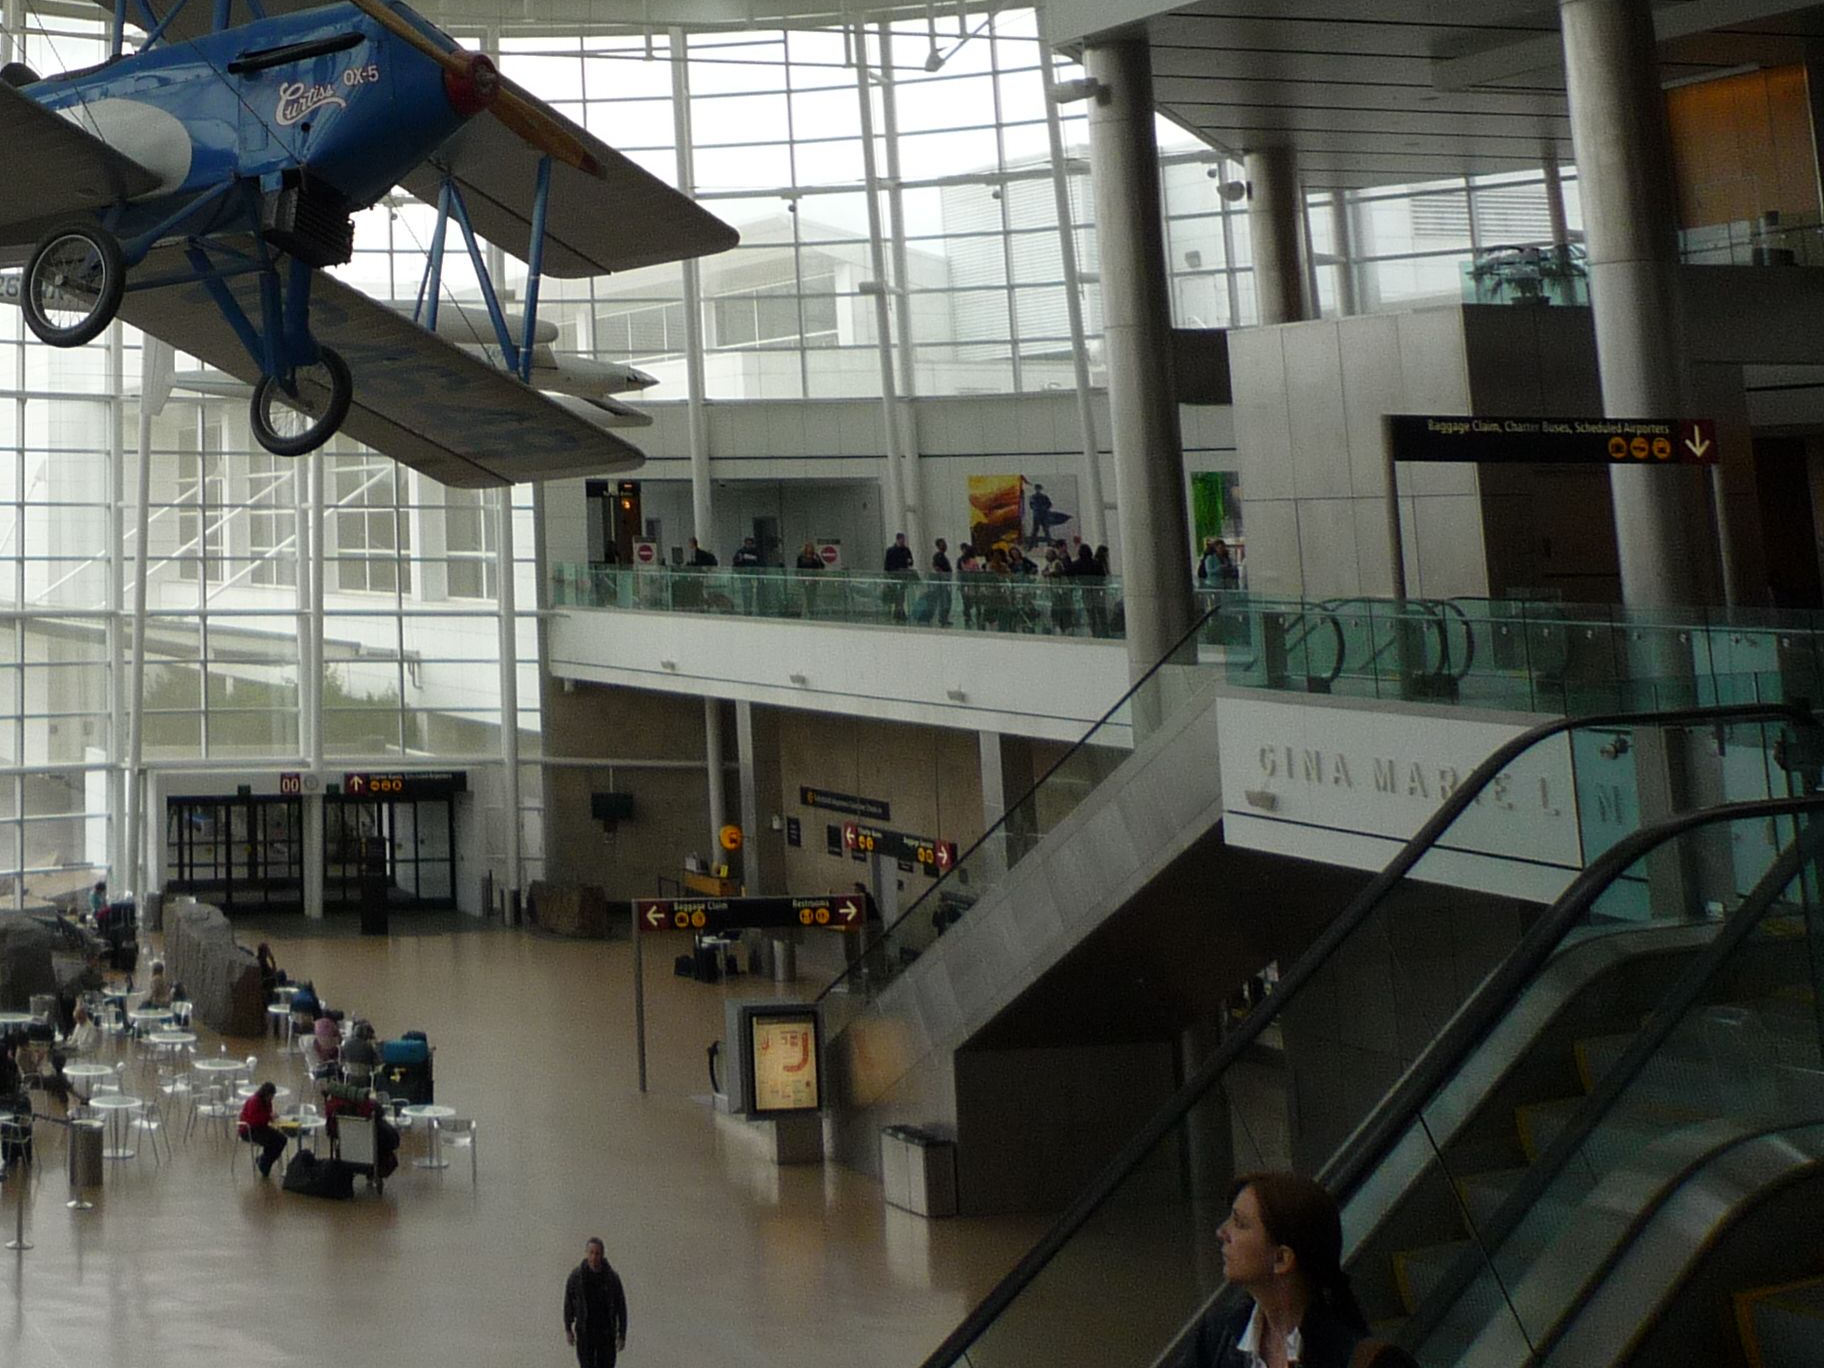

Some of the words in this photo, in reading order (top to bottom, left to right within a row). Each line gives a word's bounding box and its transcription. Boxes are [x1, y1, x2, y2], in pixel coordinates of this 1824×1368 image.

[343, 65, 379, 87] OX-5
[275, 82, 346, 126] Curtiss
[1427, 418, 1470, 434] Baggage
[1472, 419, 1502, 433] Claim,
[1575, 422, 1622, 434] Scheduled
[1624, 422, 1670, 436] Airporters
[1259, 745, 1352, 789] GINA
[1374, 757, 1515, 811] MARE
